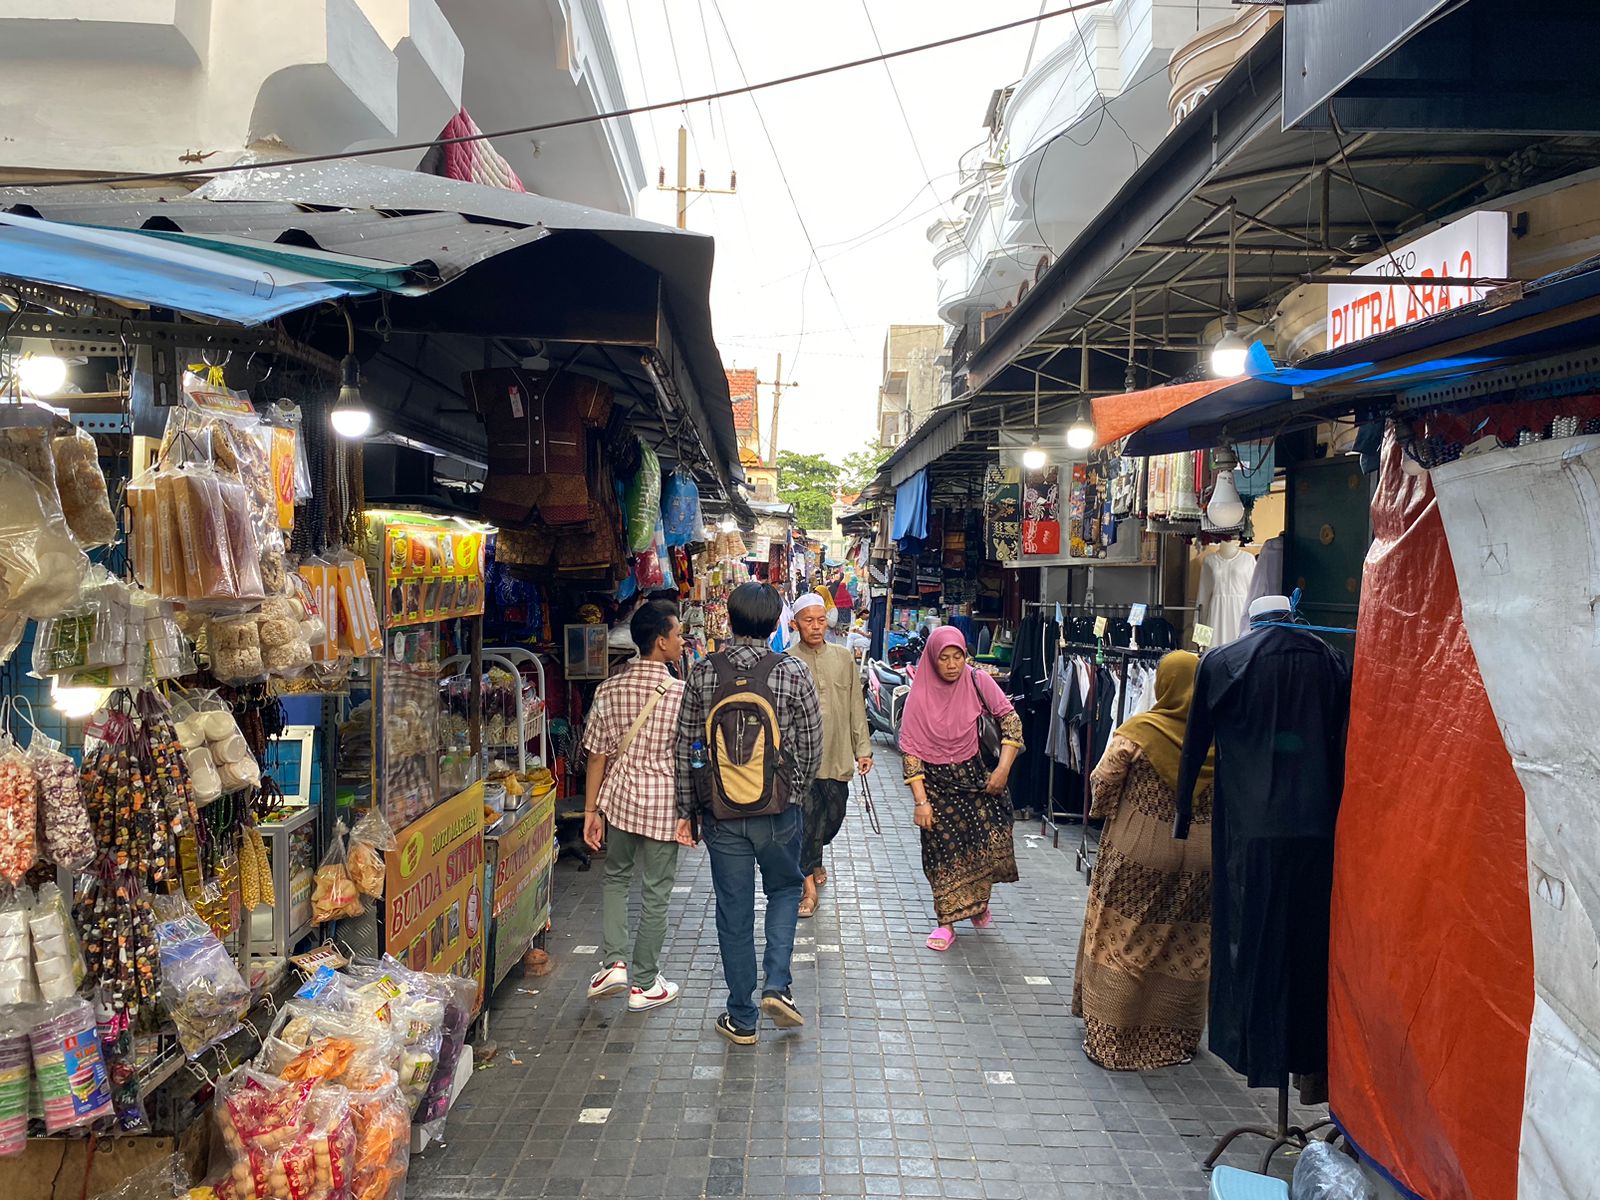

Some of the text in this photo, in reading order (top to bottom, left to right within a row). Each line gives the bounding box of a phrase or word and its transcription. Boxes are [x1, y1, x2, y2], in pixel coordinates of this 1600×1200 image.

[1331, 284, 1397, 349] PUTRA
[1459, 250, 1473, 305] 3
[1376, 250, 1417, 277] TOKO
[391, 864, 443, 939] BUNDA
